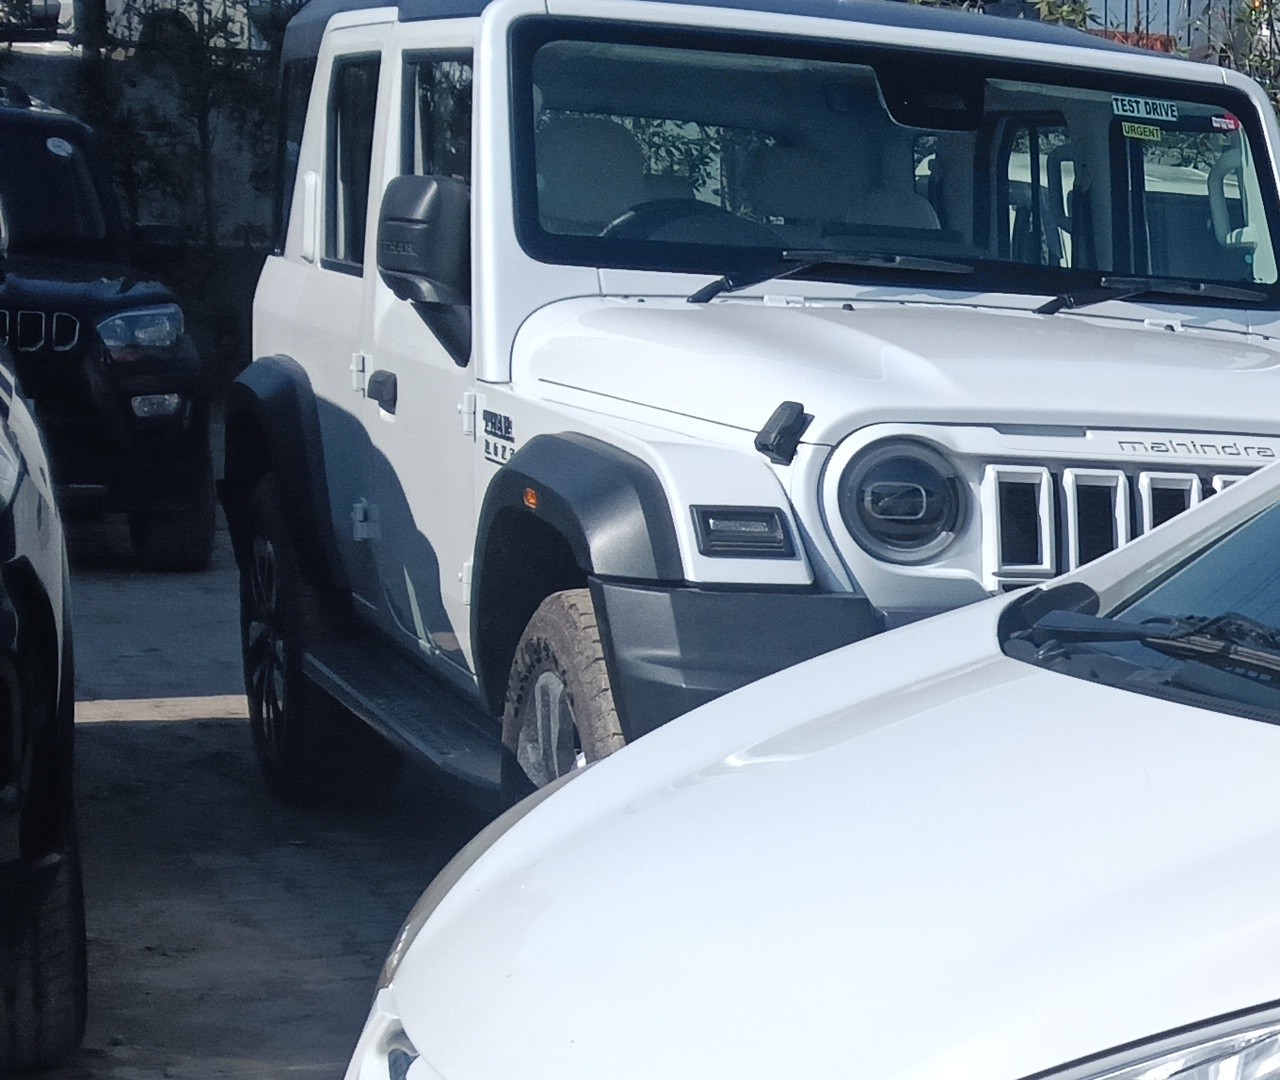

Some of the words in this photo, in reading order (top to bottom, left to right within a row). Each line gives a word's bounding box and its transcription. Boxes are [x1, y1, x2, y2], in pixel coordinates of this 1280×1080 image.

[1113, 97, 1141, 113] TEST
[1144, 102, 1177, 118] DRIVE
[1124, 125, 1160, 138] URGENT
[1118, 440, 1275, 457] mahindra
